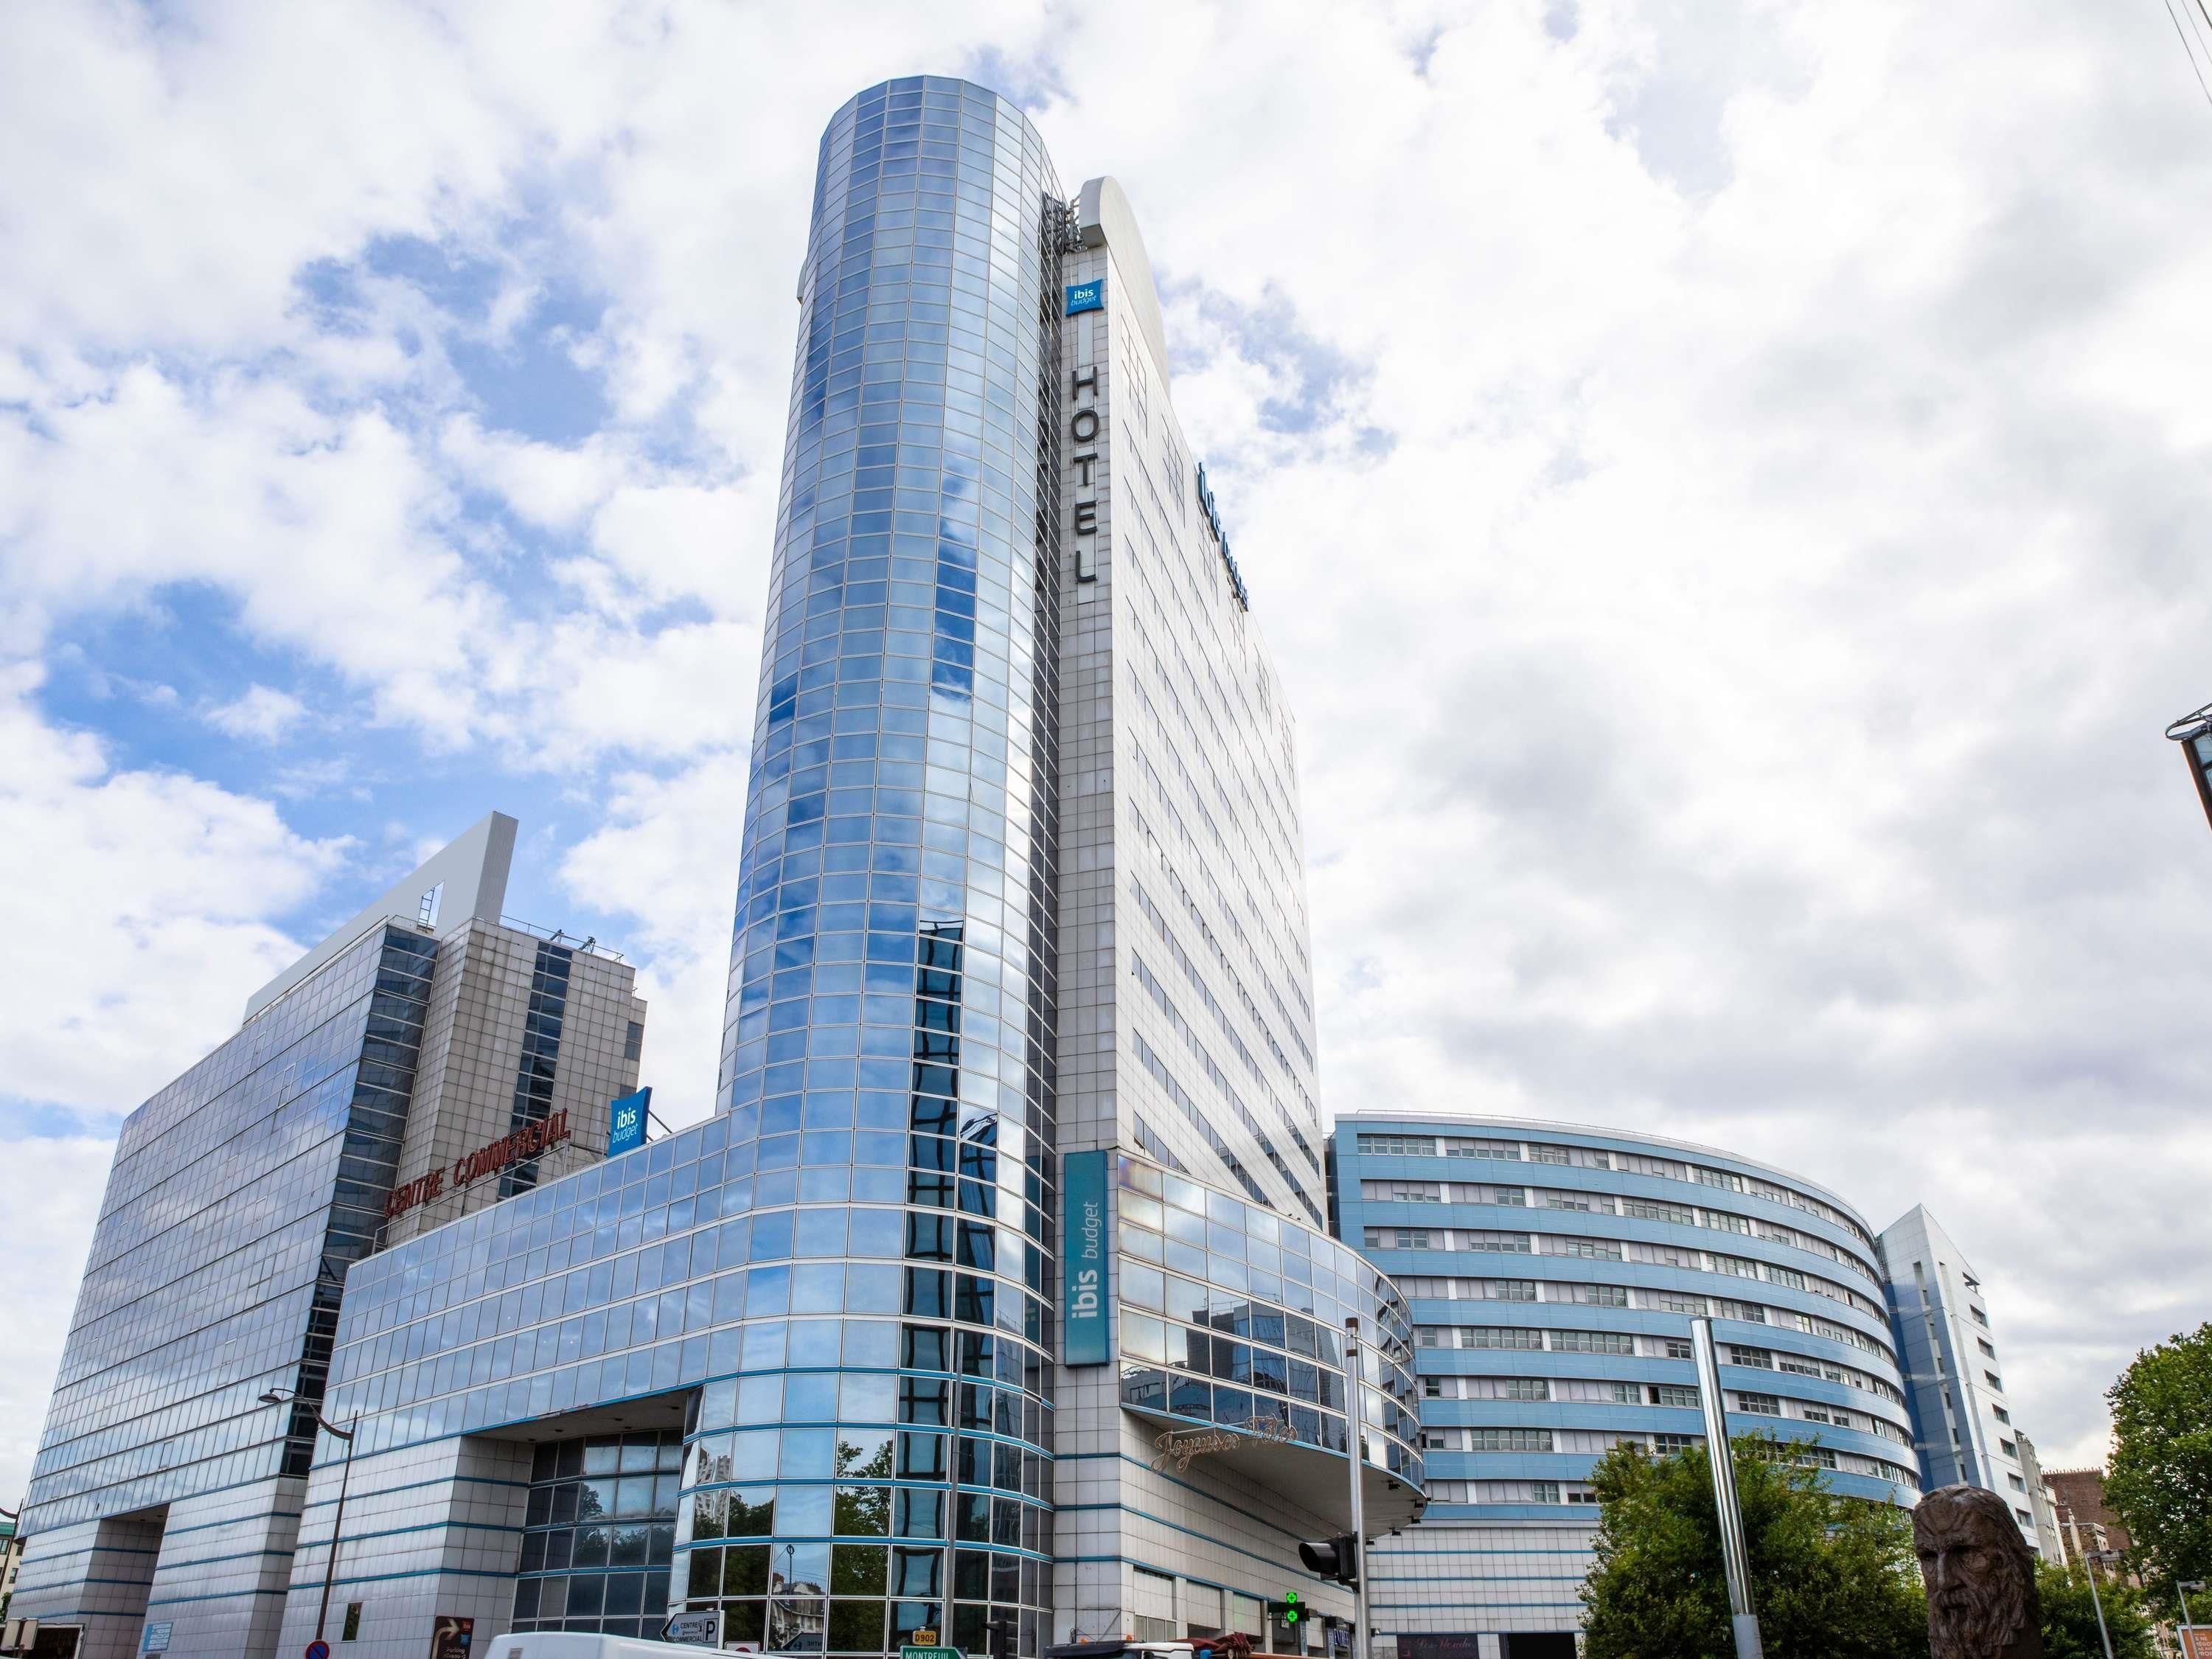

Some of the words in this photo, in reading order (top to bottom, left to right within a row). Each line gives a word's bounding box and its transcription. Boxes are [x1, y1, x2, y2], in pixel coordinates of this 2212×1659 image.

[1071, 295, 1097, 307] budget
[1074, 288, 1094, 299] ibis
[1071, 366, 1099, 583] HOTEL
[617, 1107, 636, 1130] ibis
[612, 1122, 639, 1144] budget
[385, 1167, 446, 1217] CENTRE
[453, 1108, 571, 1187] COMMERCIAL
[1081, 1201, 1102, 1259] budget
[1071, 1269, 1098, 1318] ibis
[706, 1621, 716, 1641] P
[915, 1634, 935, 1642] D902
